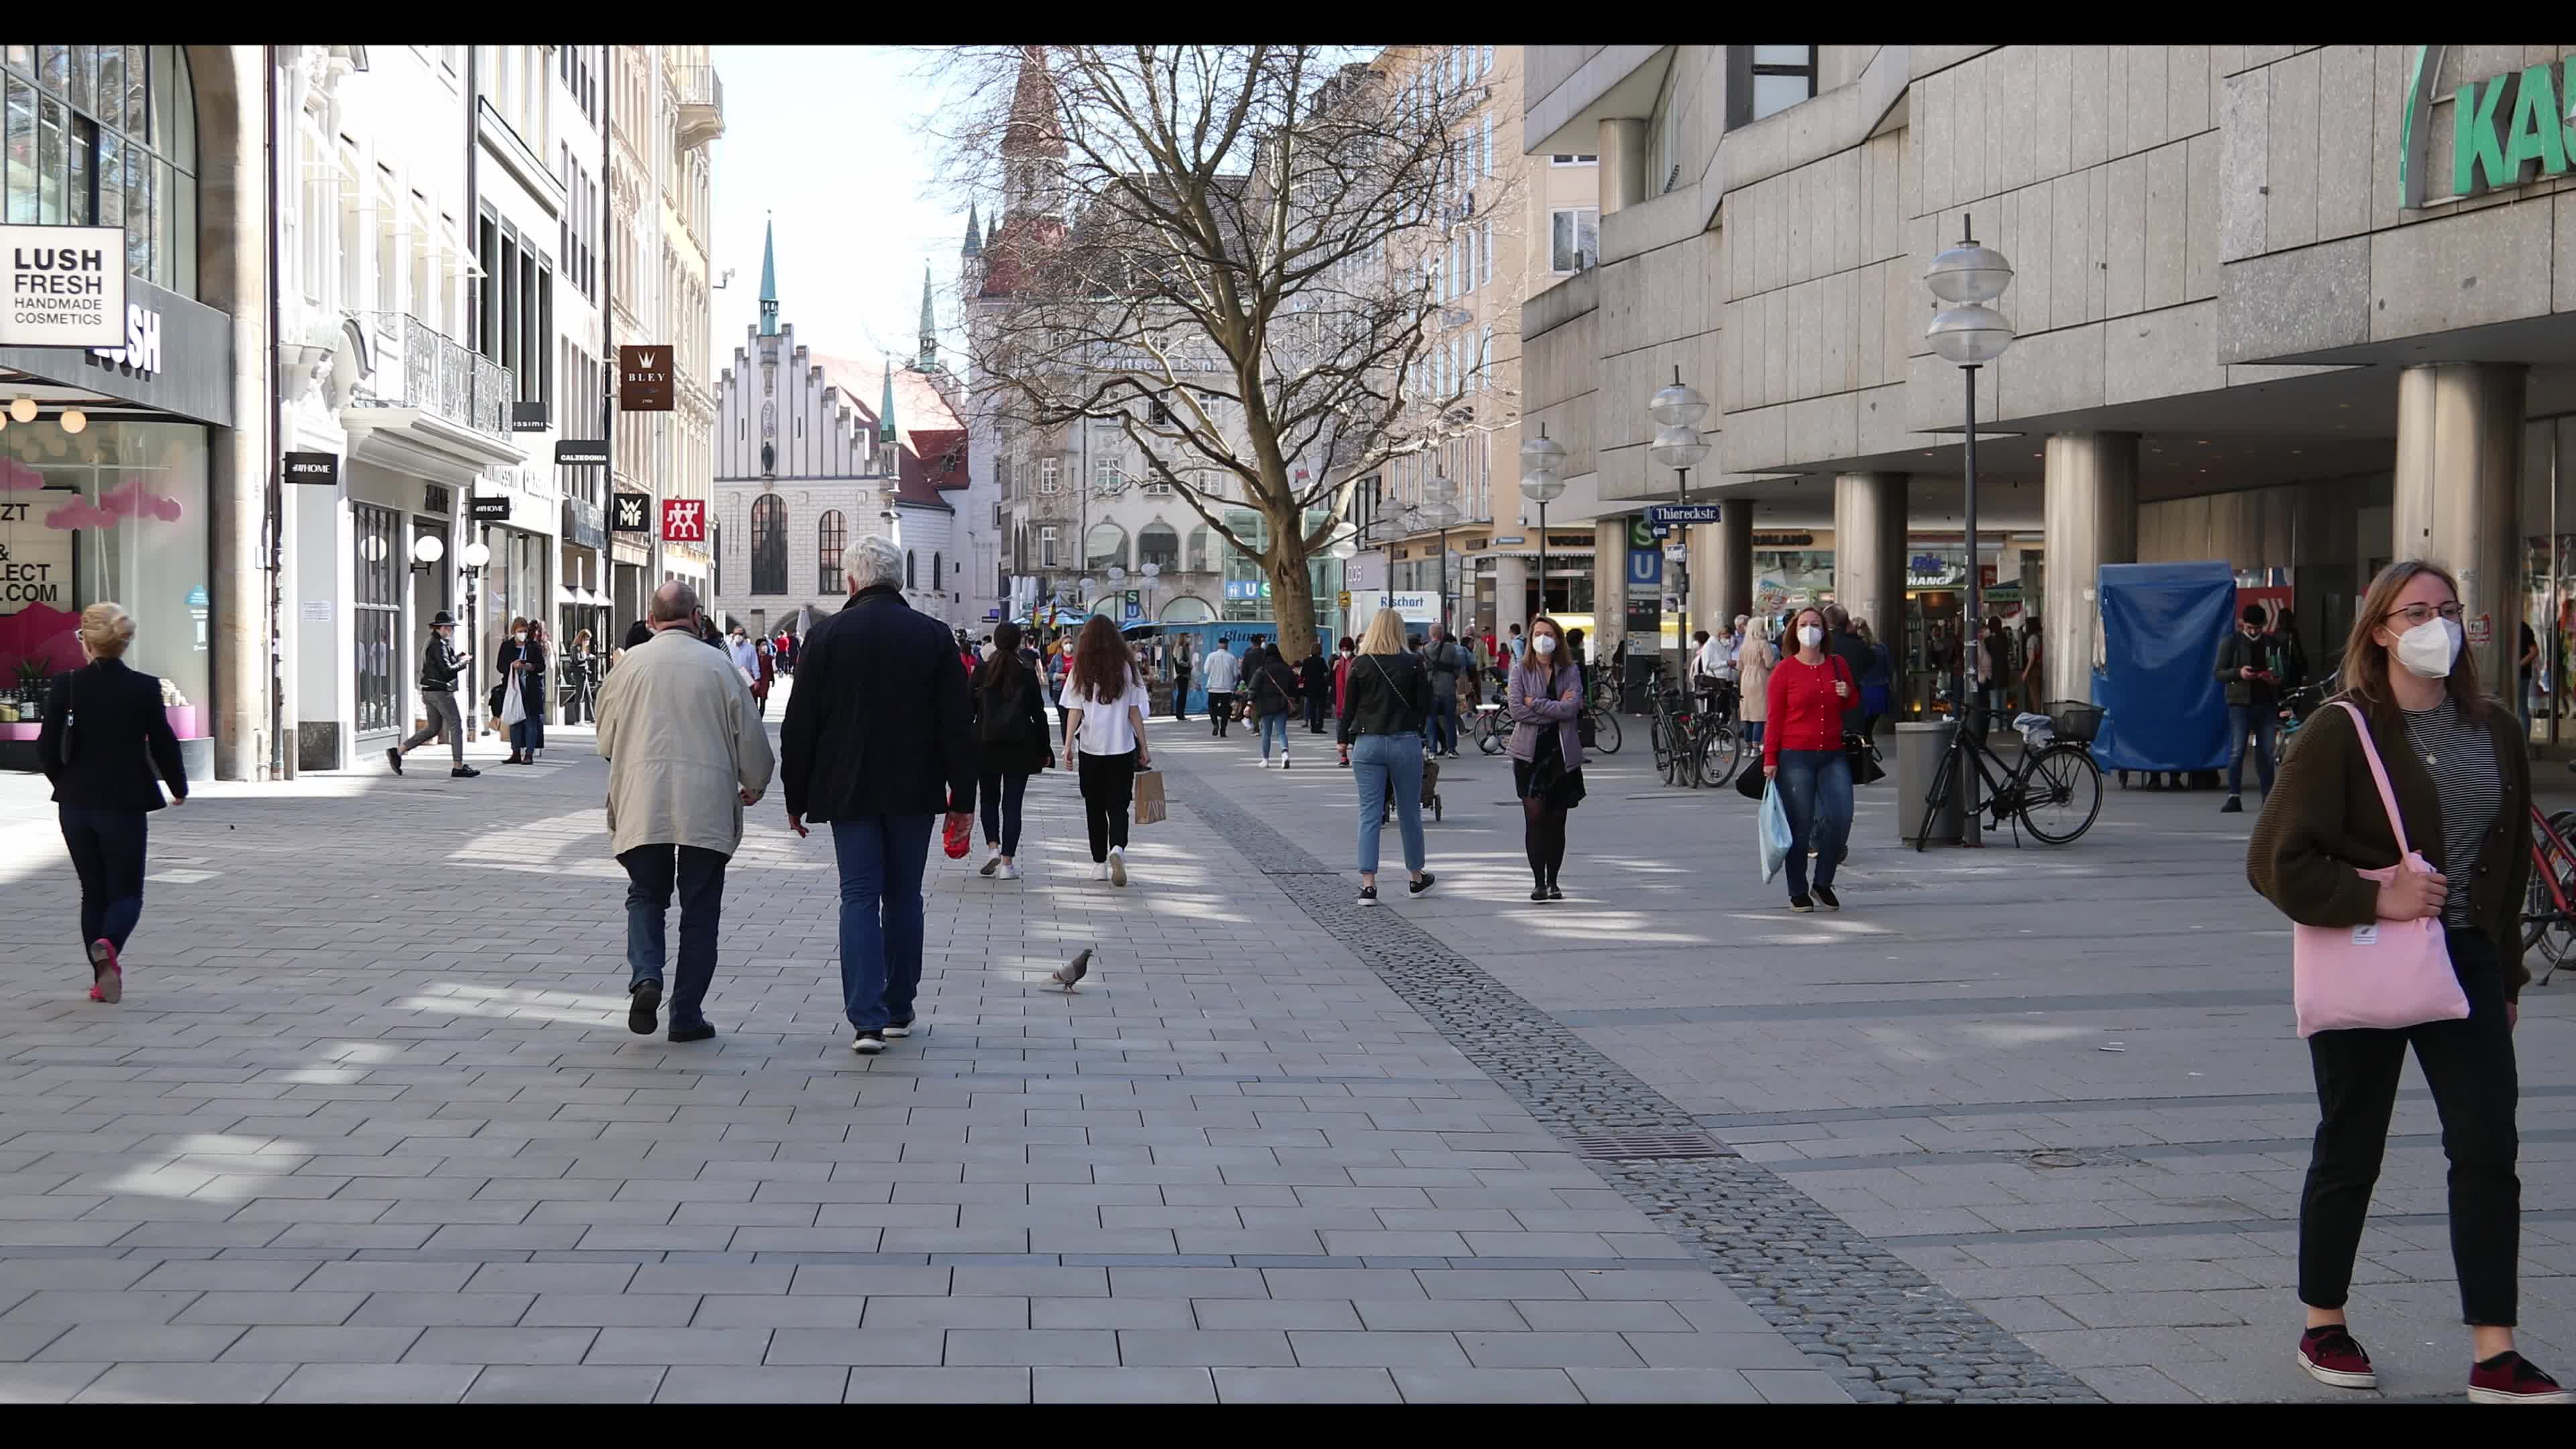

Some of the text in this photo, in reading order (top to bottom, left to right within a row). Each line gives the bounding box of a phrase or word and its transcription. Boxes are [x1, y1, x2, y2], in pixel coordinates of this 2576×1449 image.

[15, 248, 102, 271] LUSH
[15, 274, 102, 294] FRESH
[15, 297, 102, 310] HANDMADE
[15, 313, 102, 325] COSMETICS
[628, 372, 665, 382] BLEY
[307, 463, 331, 474] HOME
[487, 504, 504, 513] HOME
[1656, 507, 1717, 520] Thiereckstr.
[0, 564, 51, 582] ECT
[1634, 554, 1654, 580] U
[1245, 582, 1256, 596] U
[1128, 592, 1137, 602] S
[1380, 596, 1424, 607] Rschart
[1128, 606, 1137, 616] U
[1224, 630, 1277, 642] Blun
